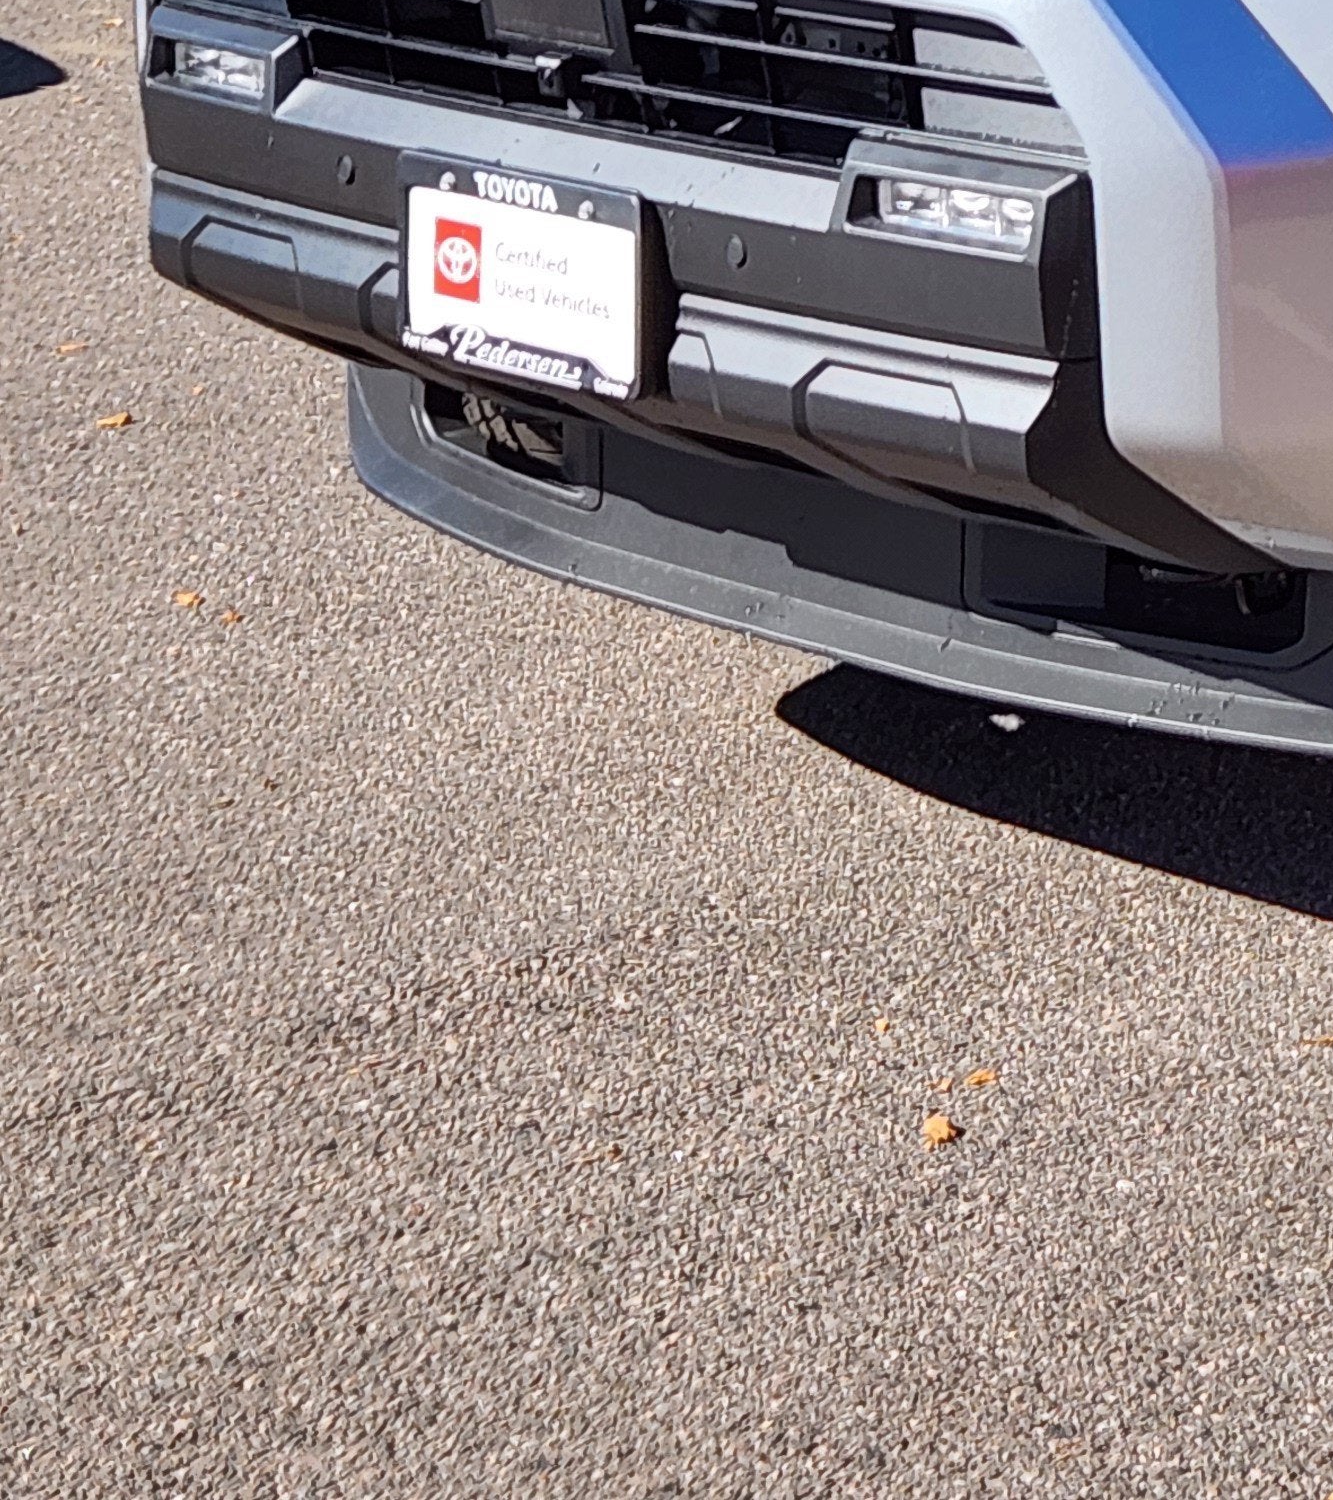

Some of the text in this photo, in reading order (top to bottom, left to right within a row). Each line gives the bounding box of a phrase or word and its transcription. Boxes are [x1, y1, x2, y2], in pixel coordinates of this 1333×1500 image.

[473, 170, 558, 213] TOYOTA
[495, 241, 569, 276] Certified
[494, 277, 536, 304] Used
[450, 322, 583, 389] Pedersen
